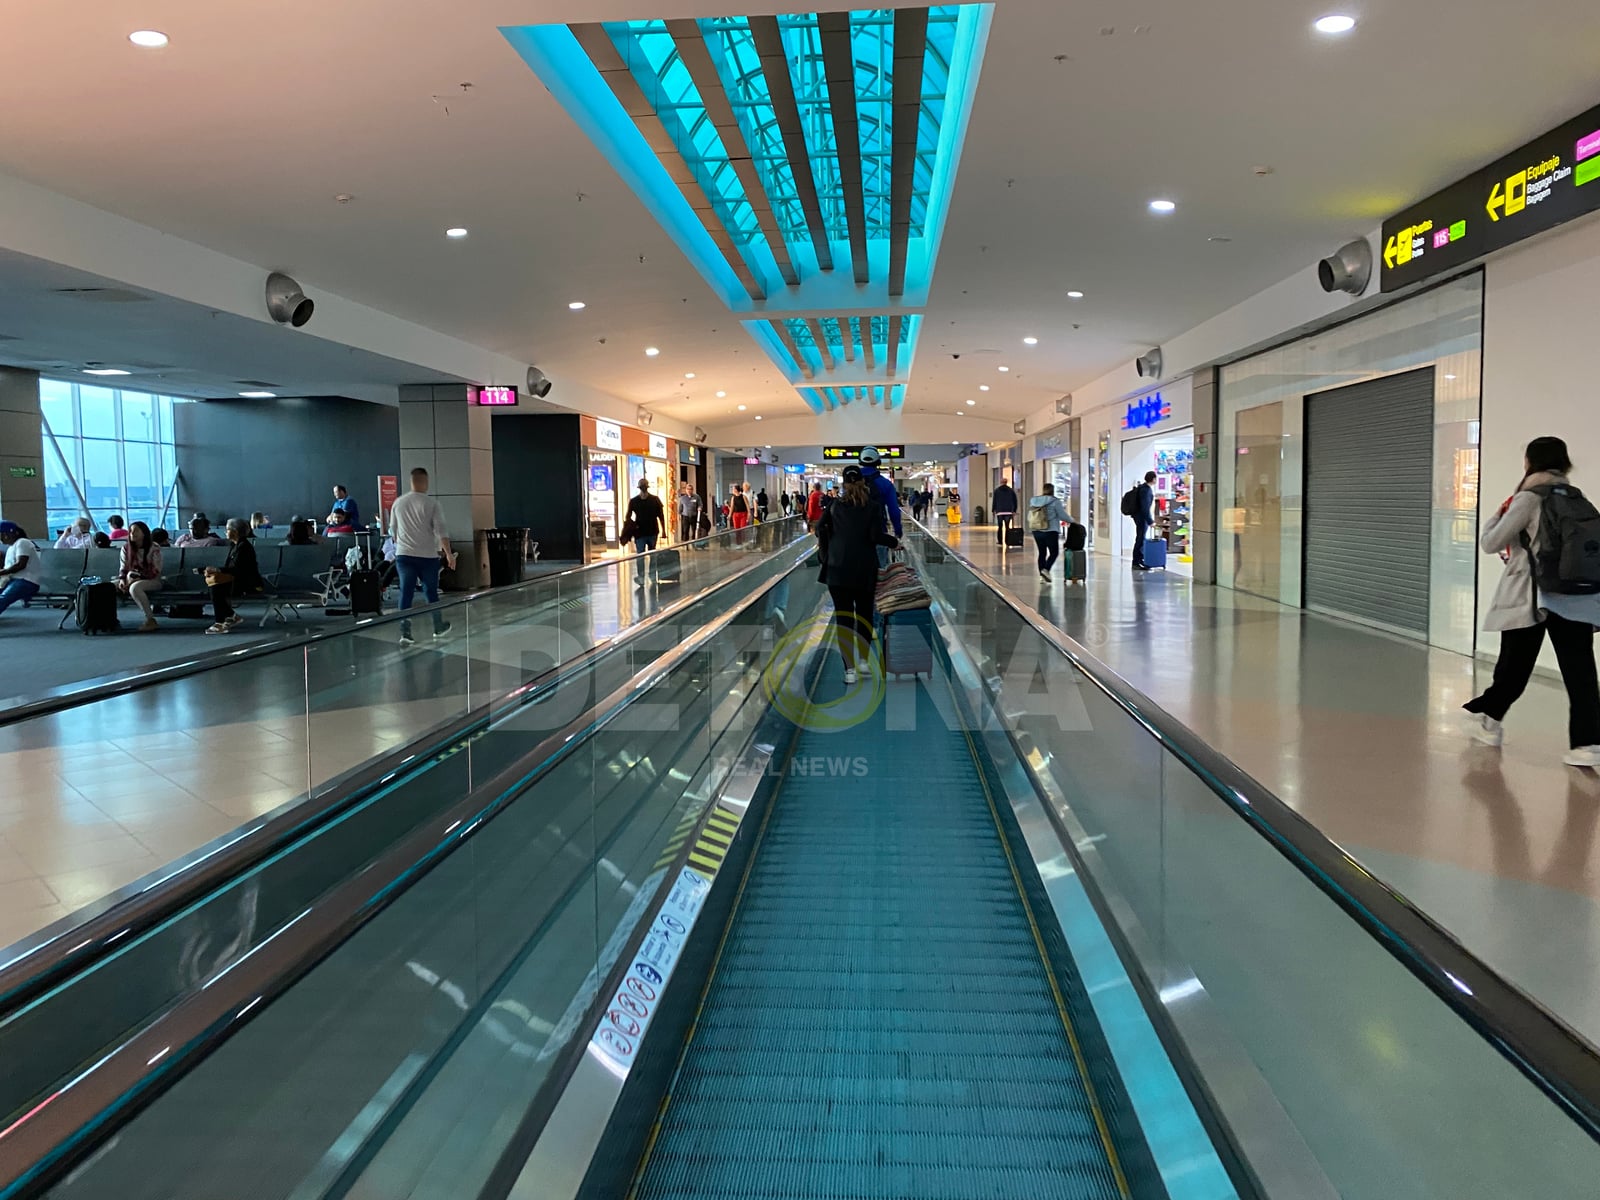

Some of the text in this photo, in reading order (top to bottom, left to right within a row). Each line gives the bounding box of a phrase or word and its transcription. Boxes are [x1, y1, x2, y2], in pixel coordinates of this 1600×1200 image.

[1527, 155, 1560, 180] Equipaje
[1527, 176, 1552, 194] Baggage
[1553, 167, 1571, 181] Claim
[486, 391, 508, 404] 114
